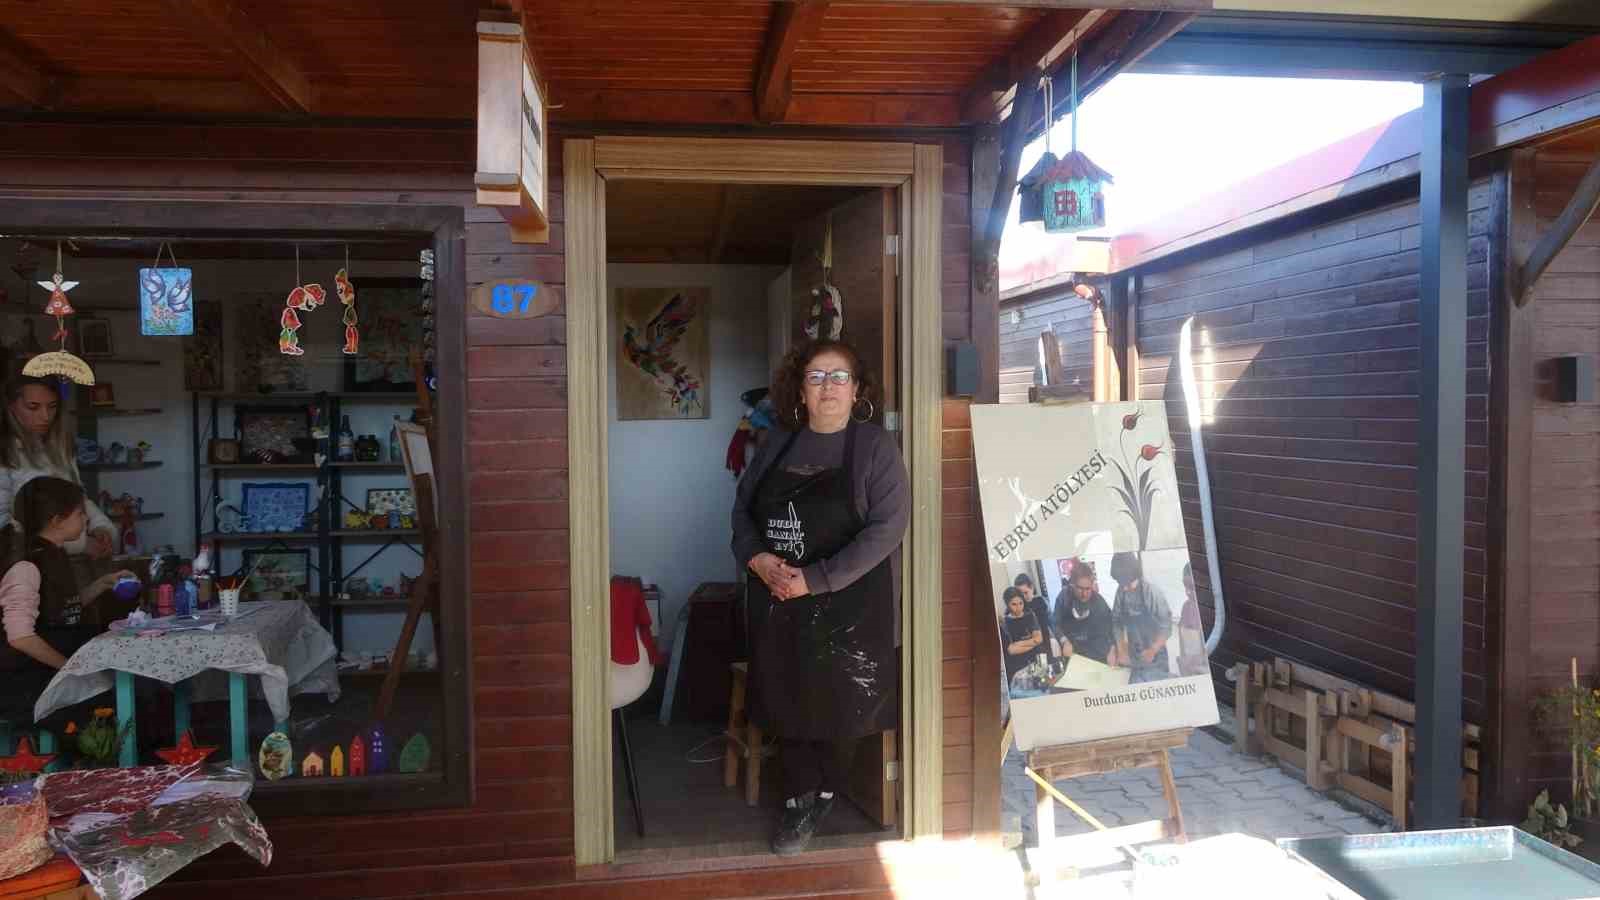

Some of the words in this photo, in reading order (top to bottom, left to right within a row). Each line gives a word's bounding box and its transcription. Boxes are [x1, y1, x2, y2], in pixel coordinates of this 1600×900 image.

[491, 284, 536, 314] 87
[993, 515, 1039, 560] EBRU
[1040, 448, 1108, 520] ATÖLYESİ
[1082, 692, 1137, 709] Durdunaz
[1138, 683, 1197, 702] GÜNAYDIN
